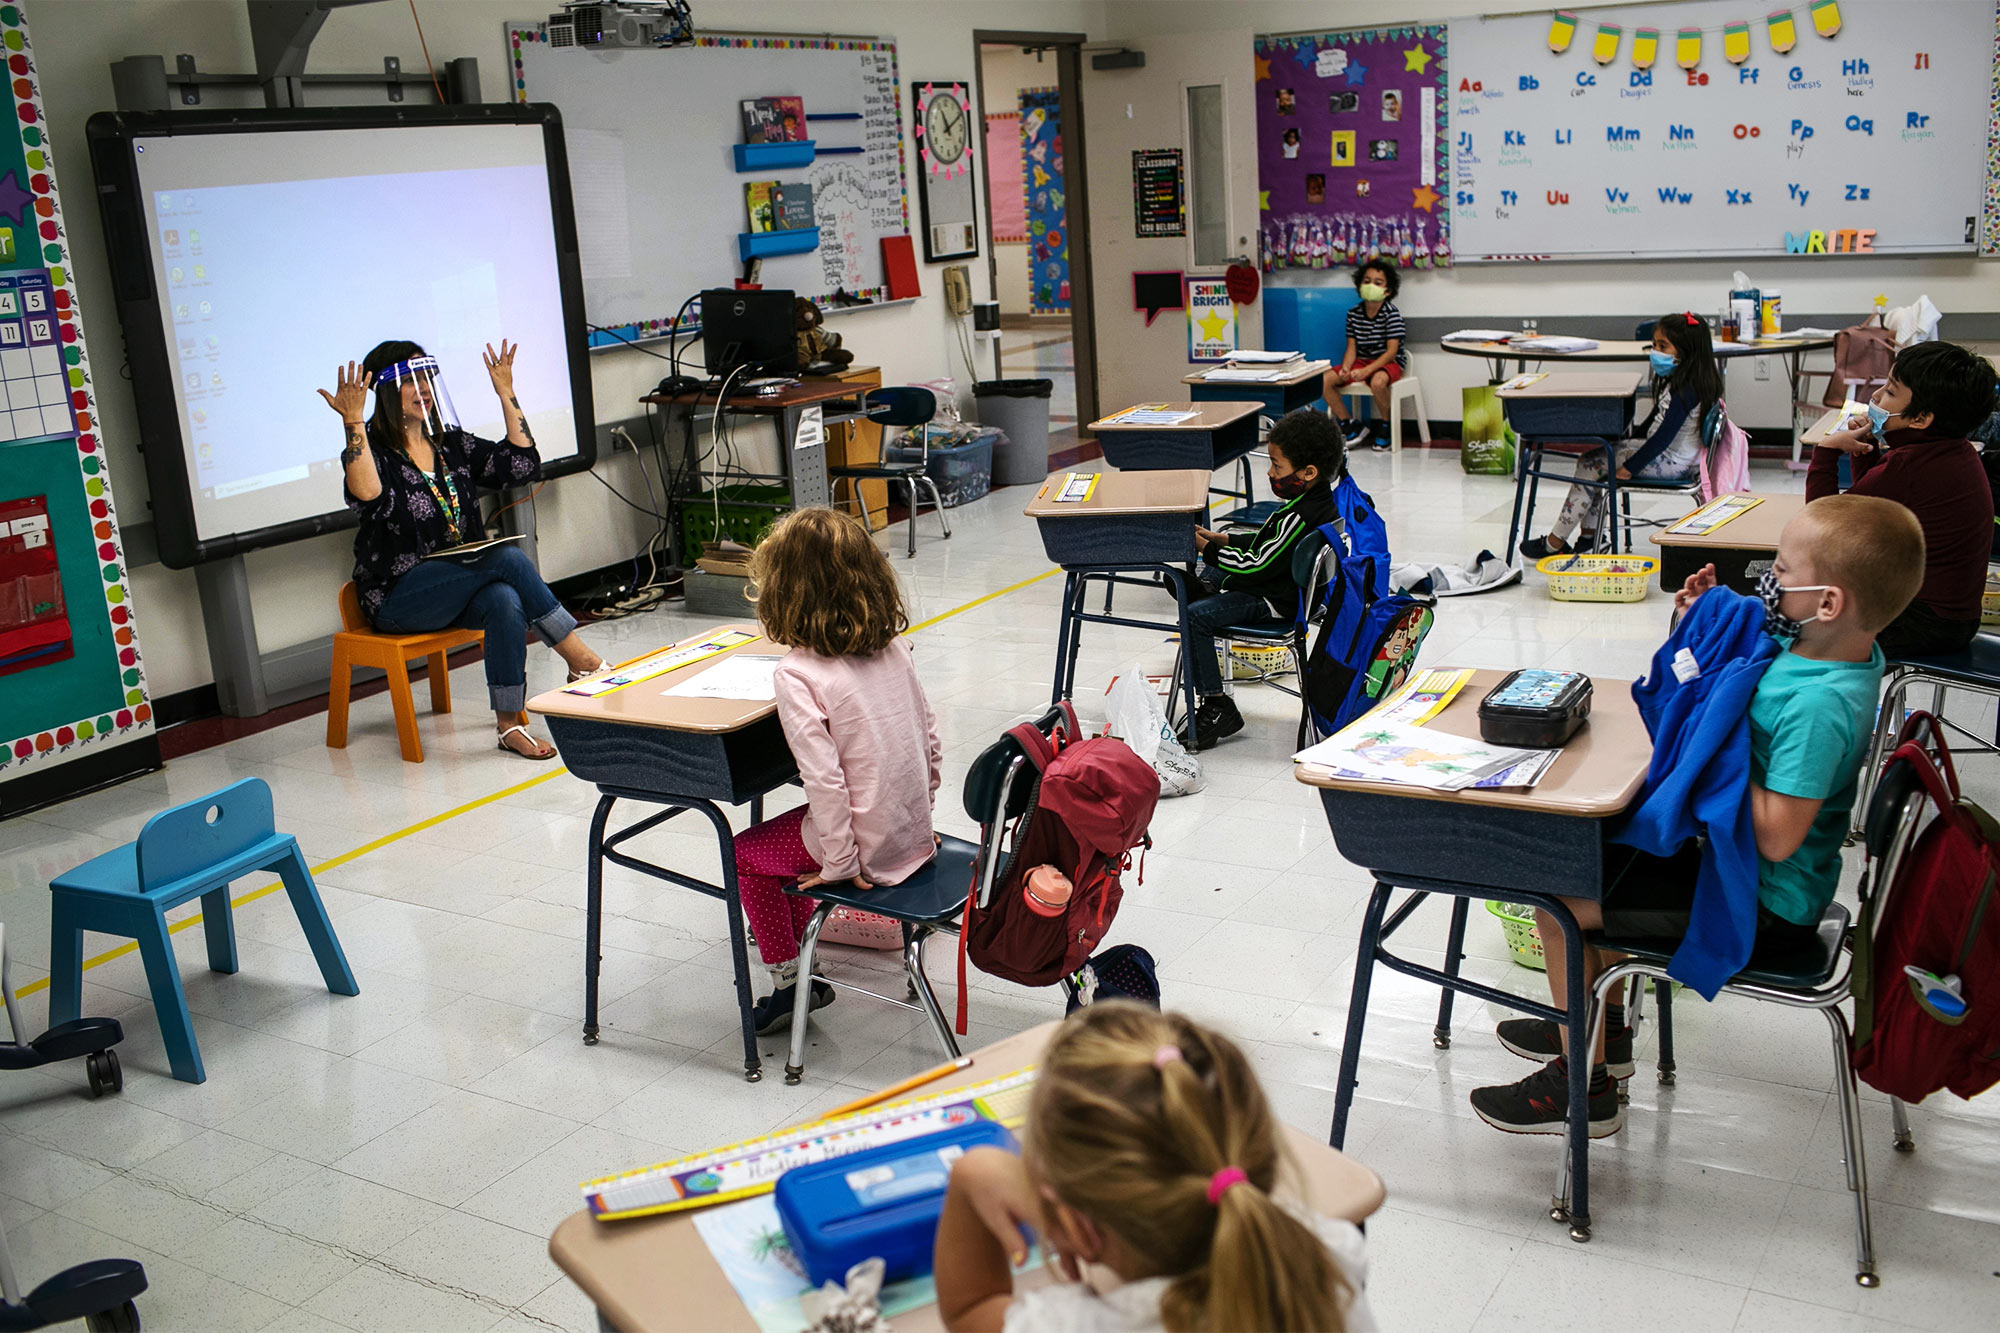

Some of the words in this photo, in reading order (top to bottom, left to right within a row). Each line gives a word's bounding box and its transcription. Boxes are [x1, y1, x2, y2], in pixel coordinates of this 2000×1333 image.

[1789, 66, 1803, 82] G
[1842, 58, 1870, 76] Hh
[1518, 74, 1539, 91] Bb
[1576, 71, 1597, 87] Cc
[1629, 69, 1652, 87] Dd
[1687, 69, 1709, 86] Ee
[1739, 68, 1760, 84] Ff
[1459, 77, 1482, 92] Aa
[1787, 80, 1822, 91] Genesis
[1845, 115, 1873, 136] Qq
[1906, 112, 1930, 129] Rr
[763, 119, 784, 142] Hug
[1504, 130, 1526, 146] Kk
[1555, 129, 1571, 144] Ll
[1607, 126, 1640, 142] Mm
[1669, 124, 1694, 140] Nn
[1733, 124, 1760, 140] Oo
[1791, 119, 1815, 142] Pp
[1457, 131, 1473, 152] Jj
[1786, 141, 1805, 159] play
[1456, 191, 1475, 206] Ss
[1501, 190, 1518, 206] Tt
[1547, 190, 1569, 206] Uu
[1606, 187, 1629, 203] Vv
[1658, 187, 1693, 204] Ww
[1726, 189, 1752, 206] Xx
[1788, 183, 1810, 207] Yy
[1845, 184, 1871, 201] Zz
[784, 205, 805, 215] Loves
[1495, 207, 1510, 220] the
[1784, 228, 1877, 254] WRITE
[1195, 285, 1226, 295] SHINE
[2, 297, 11, 310] 4
[31, 295, 40, 308] 5
[1193, 297, 1229, 306] BRIGHT
[5, 327, 15, 340] 11
[33, 324, 47, 337] 12
[34, 534, 40, 543] 7
